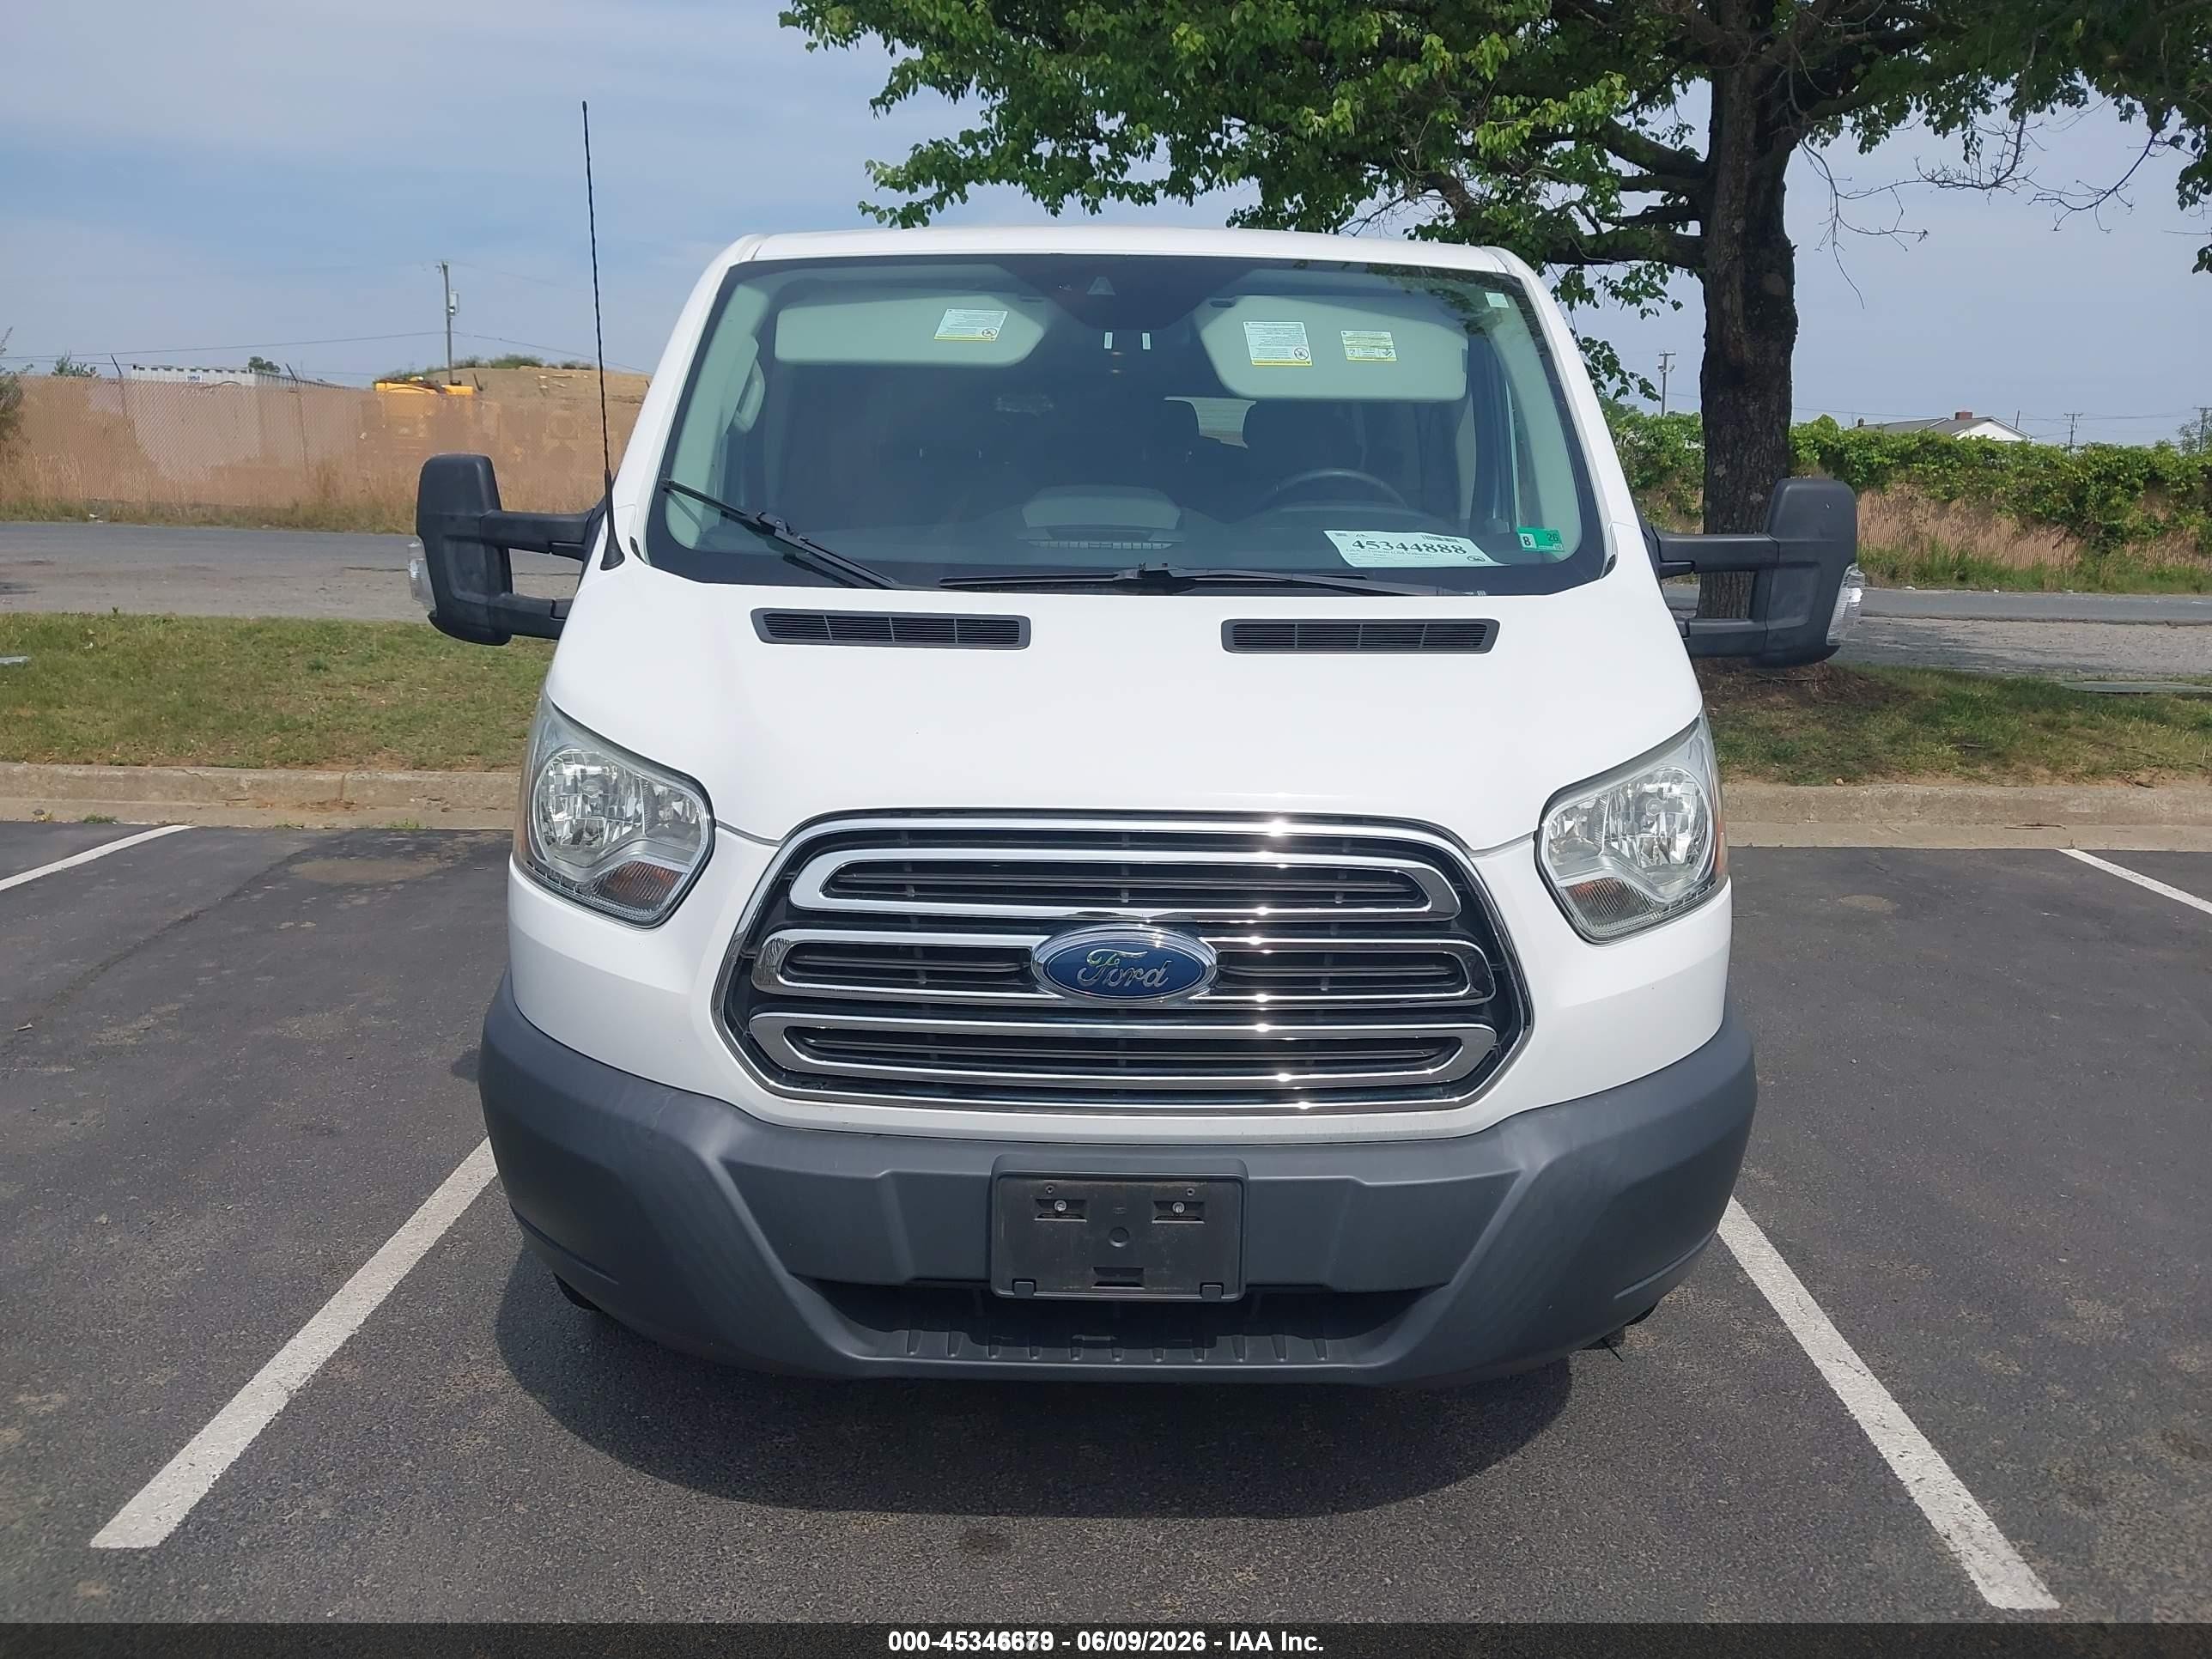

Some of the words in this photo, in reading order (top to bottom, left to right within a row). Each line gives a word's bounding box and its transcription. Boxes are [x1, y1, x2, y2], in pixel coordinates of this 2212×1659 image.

[1546, 533, 1559, 542] 26
[1352, 540, 1468, 555] 45344888
[1077, 948, 1173, 988] Ford
